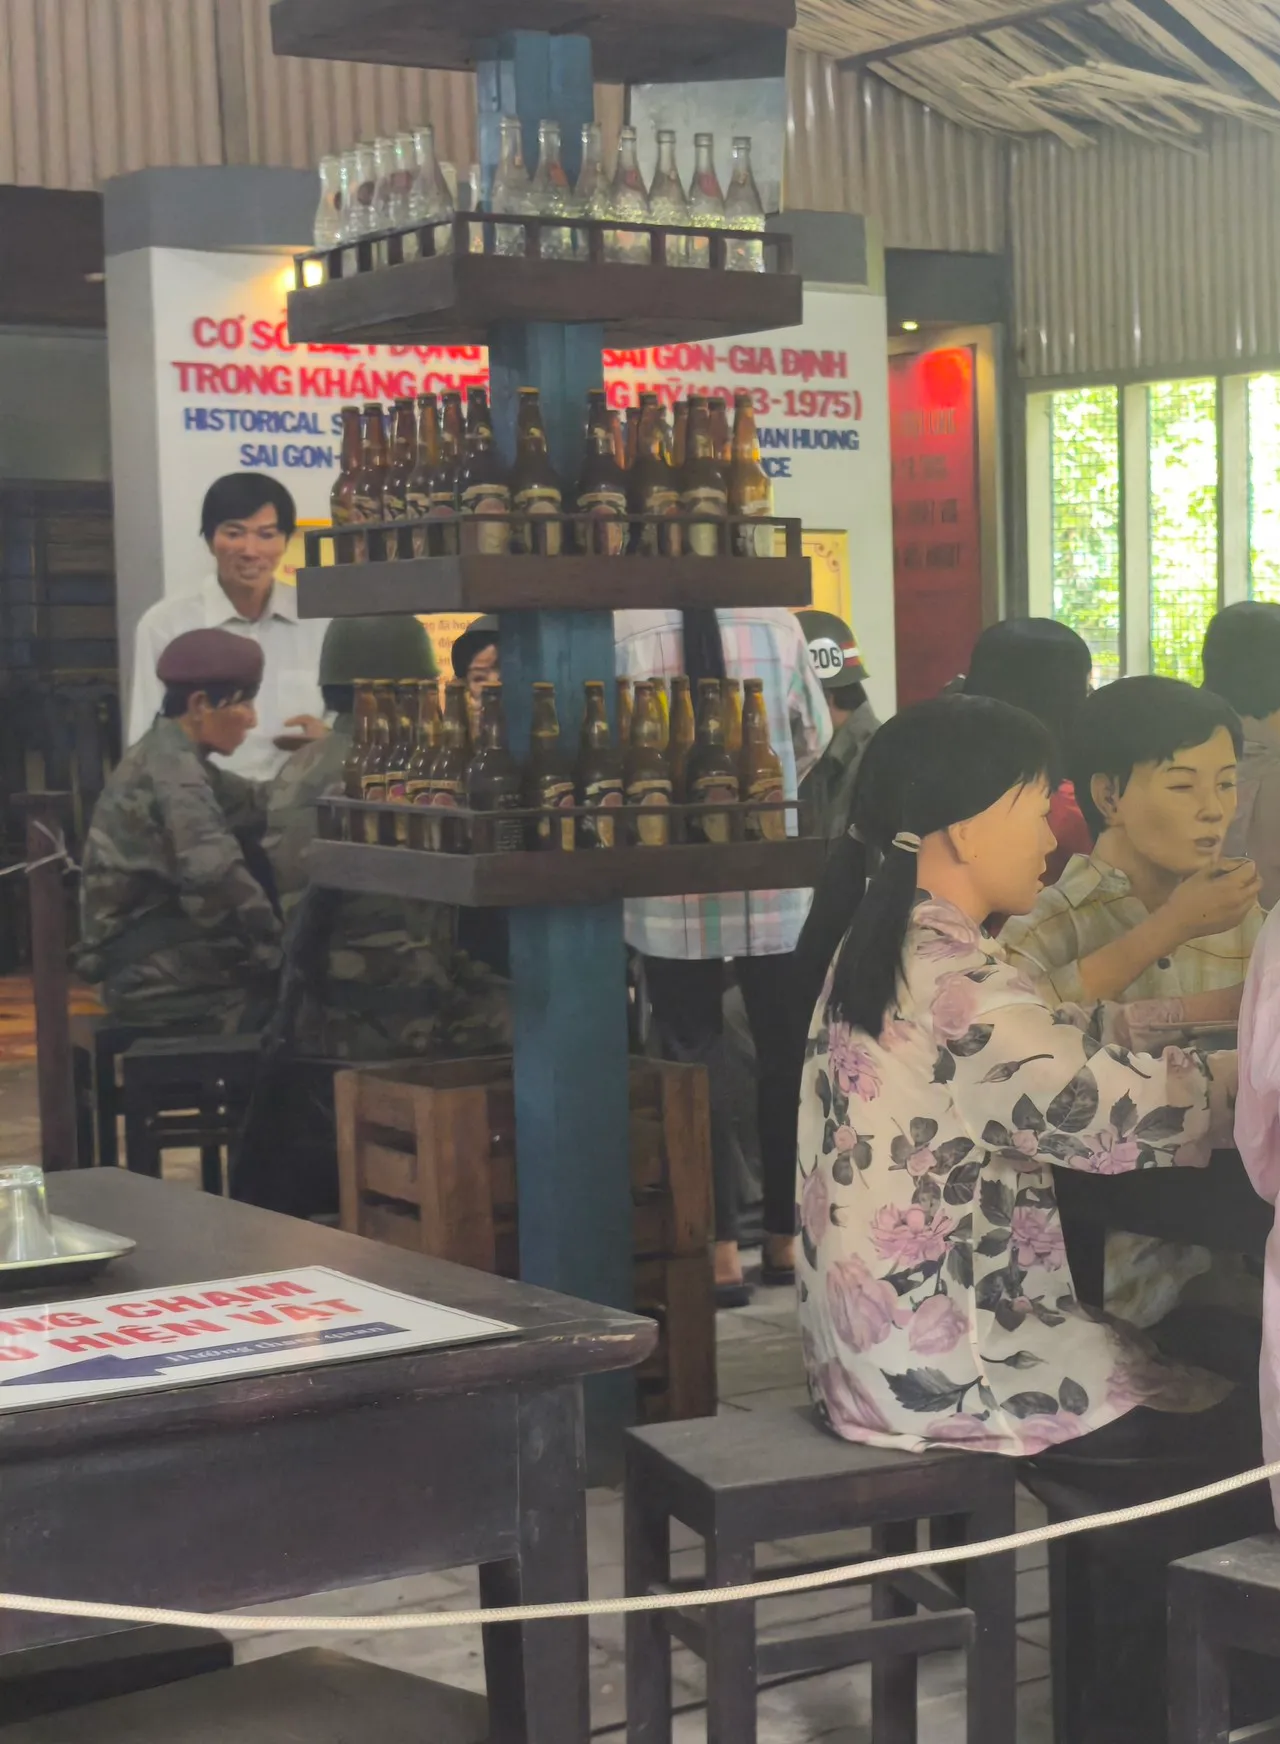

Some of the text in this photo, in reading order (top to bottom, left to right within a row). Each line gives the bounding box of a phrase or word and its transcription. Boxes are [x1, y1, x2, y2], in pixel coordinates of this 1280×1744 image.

[171, 361, 293, 397] TRONG
[298, 362, 417, 400] KHÁNG
[780, 345, 848, 383] ĐỊNH
[184, 407, 325, 434] HISTORICAL
[793, 428, 860, 450] HUONG
[240, 443, 279, 467] SAI
[105, 1280, 317, 1319] CHẠM
[47, 1318, 232, 1354] HIỆN
[225, 1297, 364, 1327] VẬT
